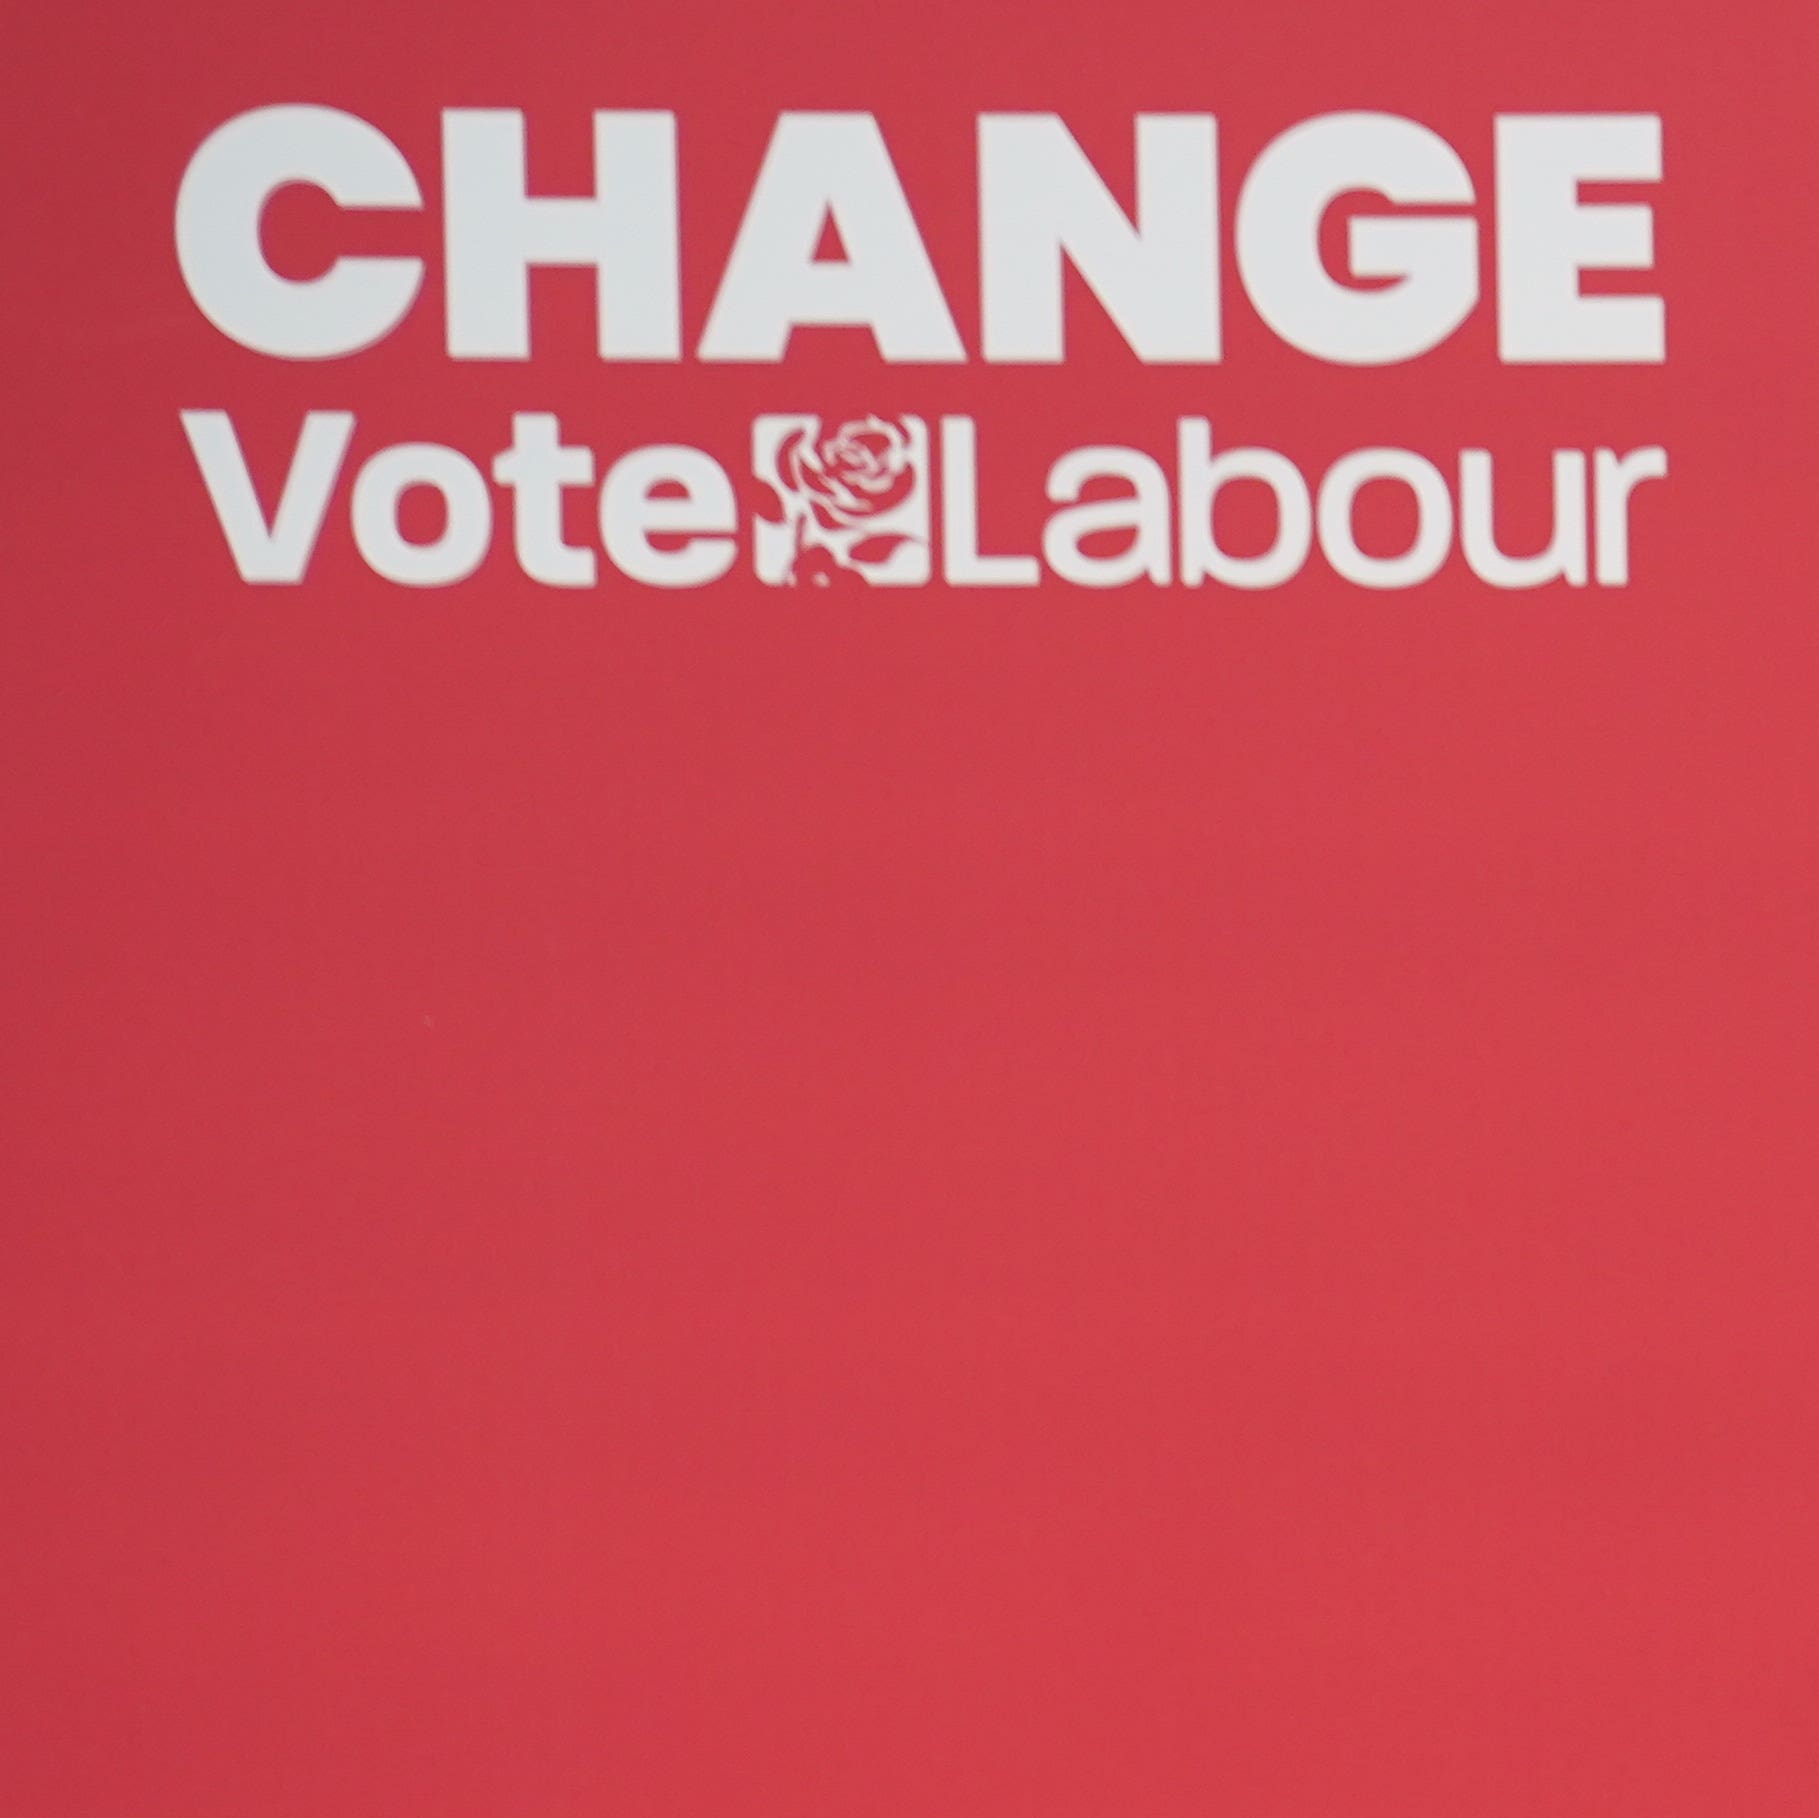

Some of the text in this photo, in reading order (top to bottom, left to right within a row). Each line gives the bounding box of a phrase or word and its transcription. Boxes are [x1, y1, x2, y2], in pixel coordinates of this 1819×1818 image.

[174, 104, 1666, 364] CHANGE
[180, 410, 1668, 589] Vote Labour
